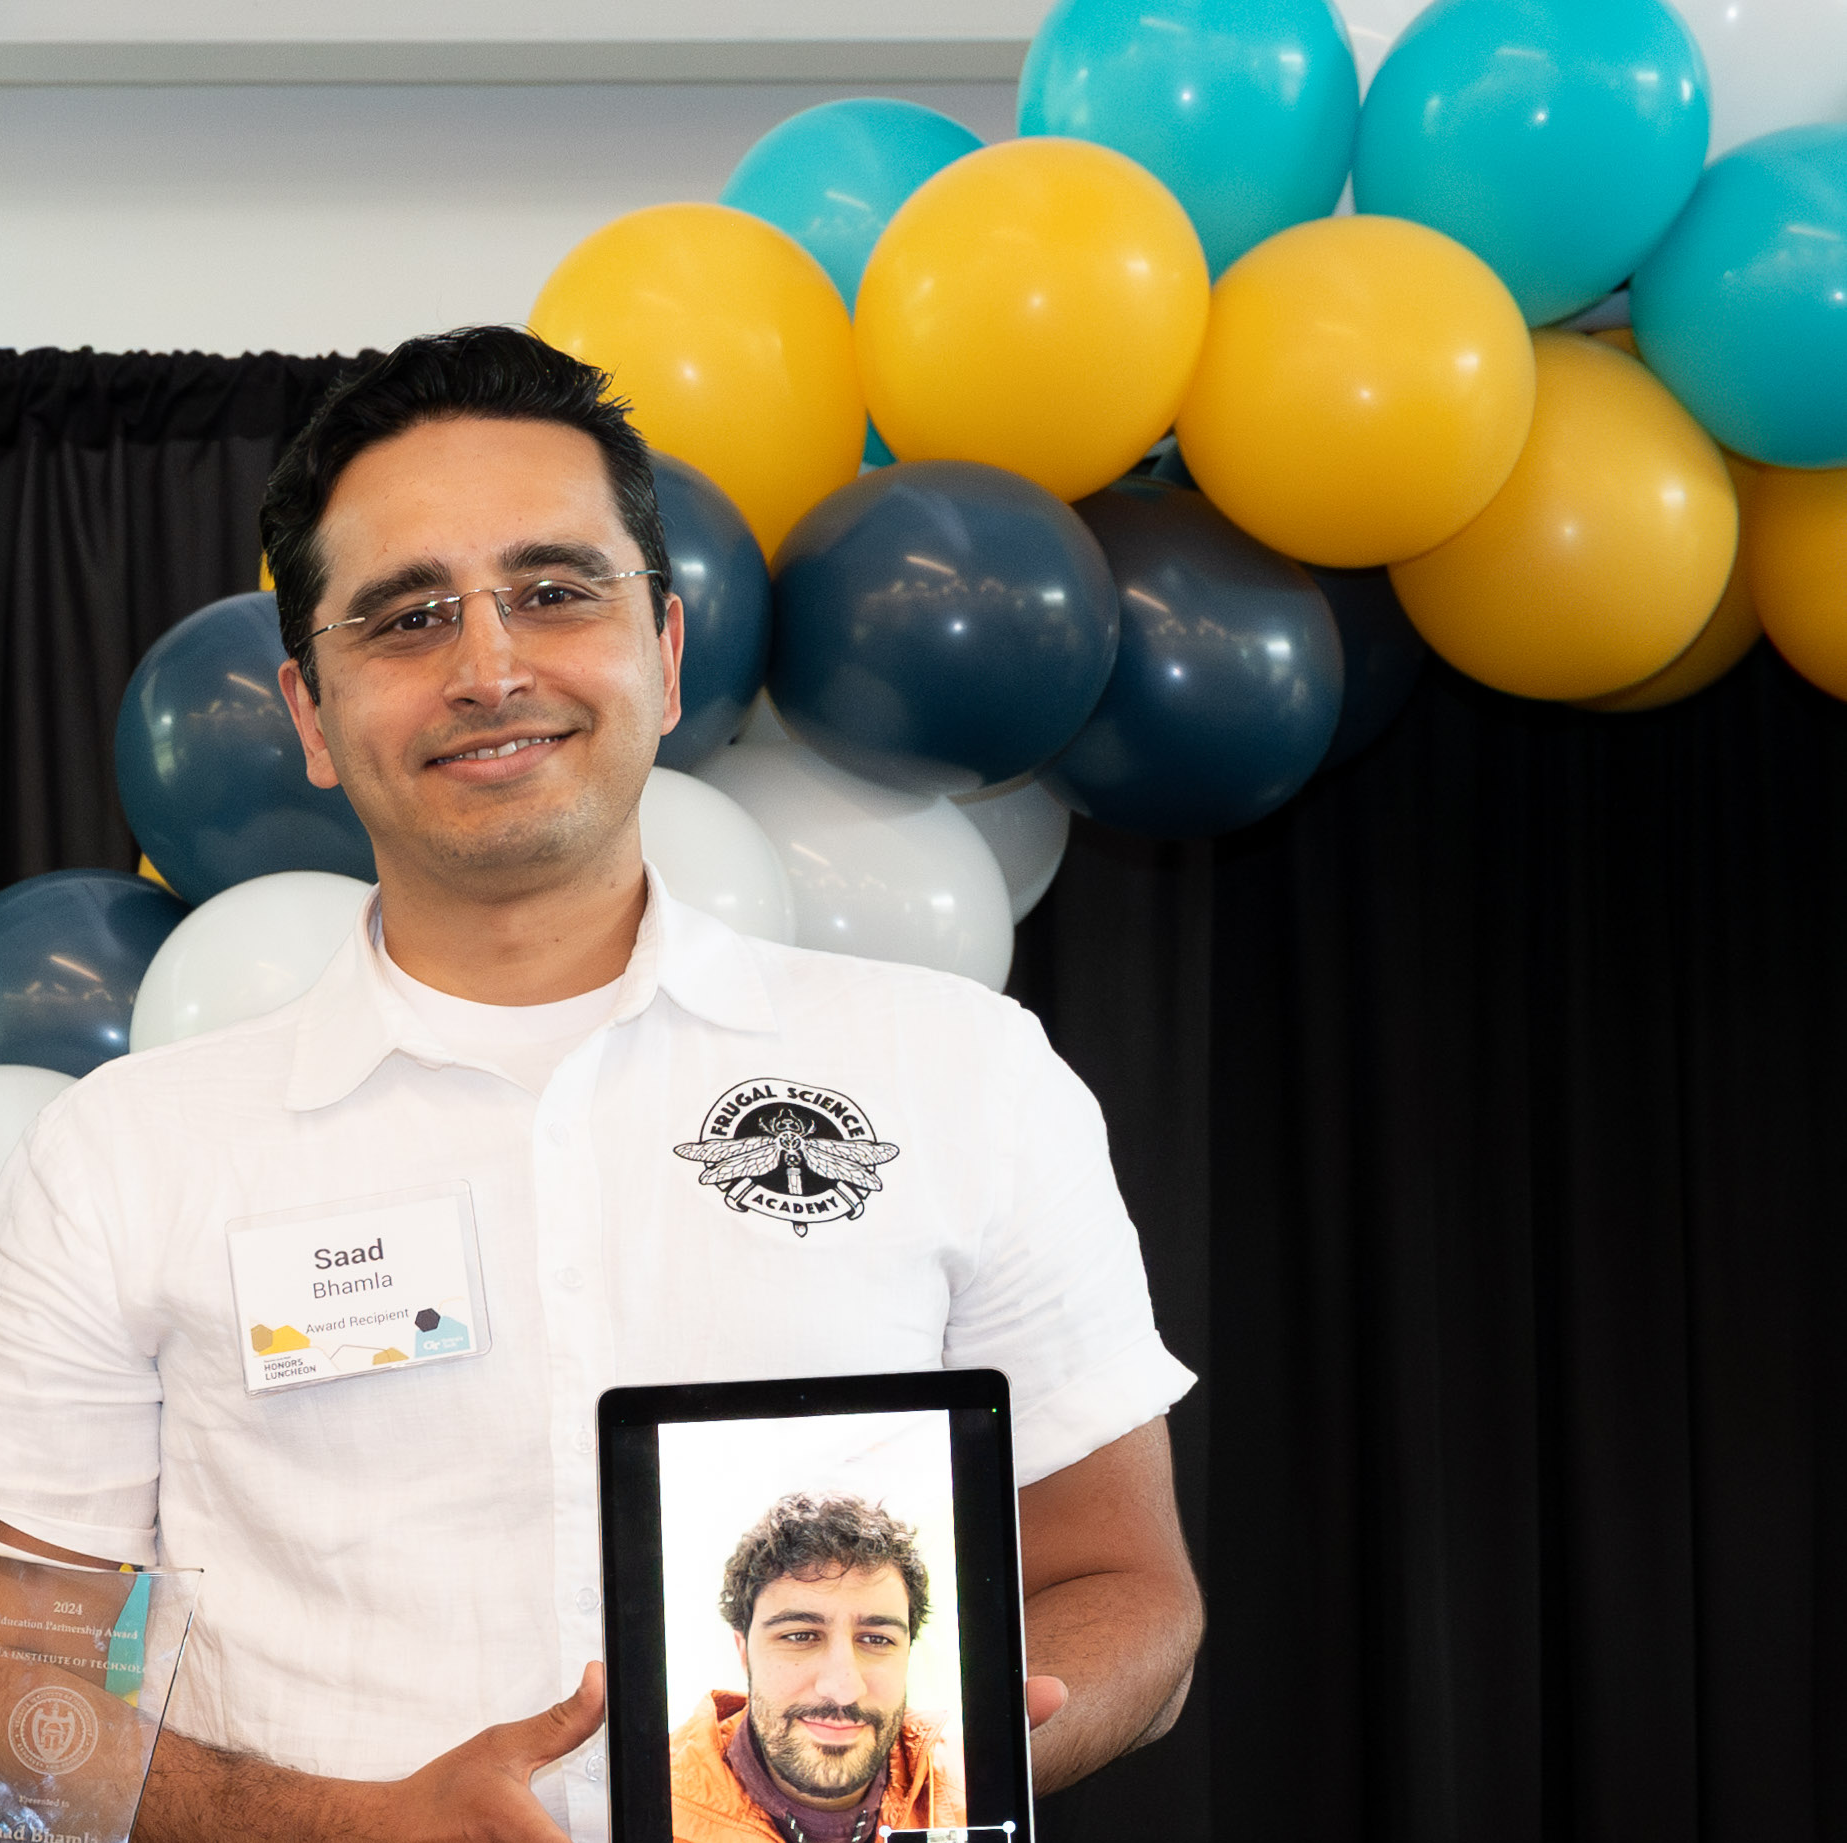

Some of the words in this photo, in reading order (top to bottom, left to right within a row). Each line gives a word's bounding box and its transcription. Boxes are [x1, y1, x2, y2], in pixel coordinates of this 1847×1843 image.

[710, 1085, 778, 1136] FRUGAL
[787, 1087, 866, 1139] SCIENCE
[752, 1193, 839, 1214] ACADEMY
[313, 1238, 384, 1269] Saad
[313, 1272, 393, 1299] Bhamla
[306, 1318, 346, 1335] Award
[350, 1308, 409, 1328] Recipient
[264, 1358, 304, 1371] HONORS
[265, 1365, 317, 1381] LUNCHEON
[53, 1601, 83, 1615] 2024
[46, 1621, 103, 1637] Partnership
[104, 1627, 138, 1640] Award
[11, 1650, 71, 1665] INSTITUTE
[73, 1657, 87, 1667] OF
